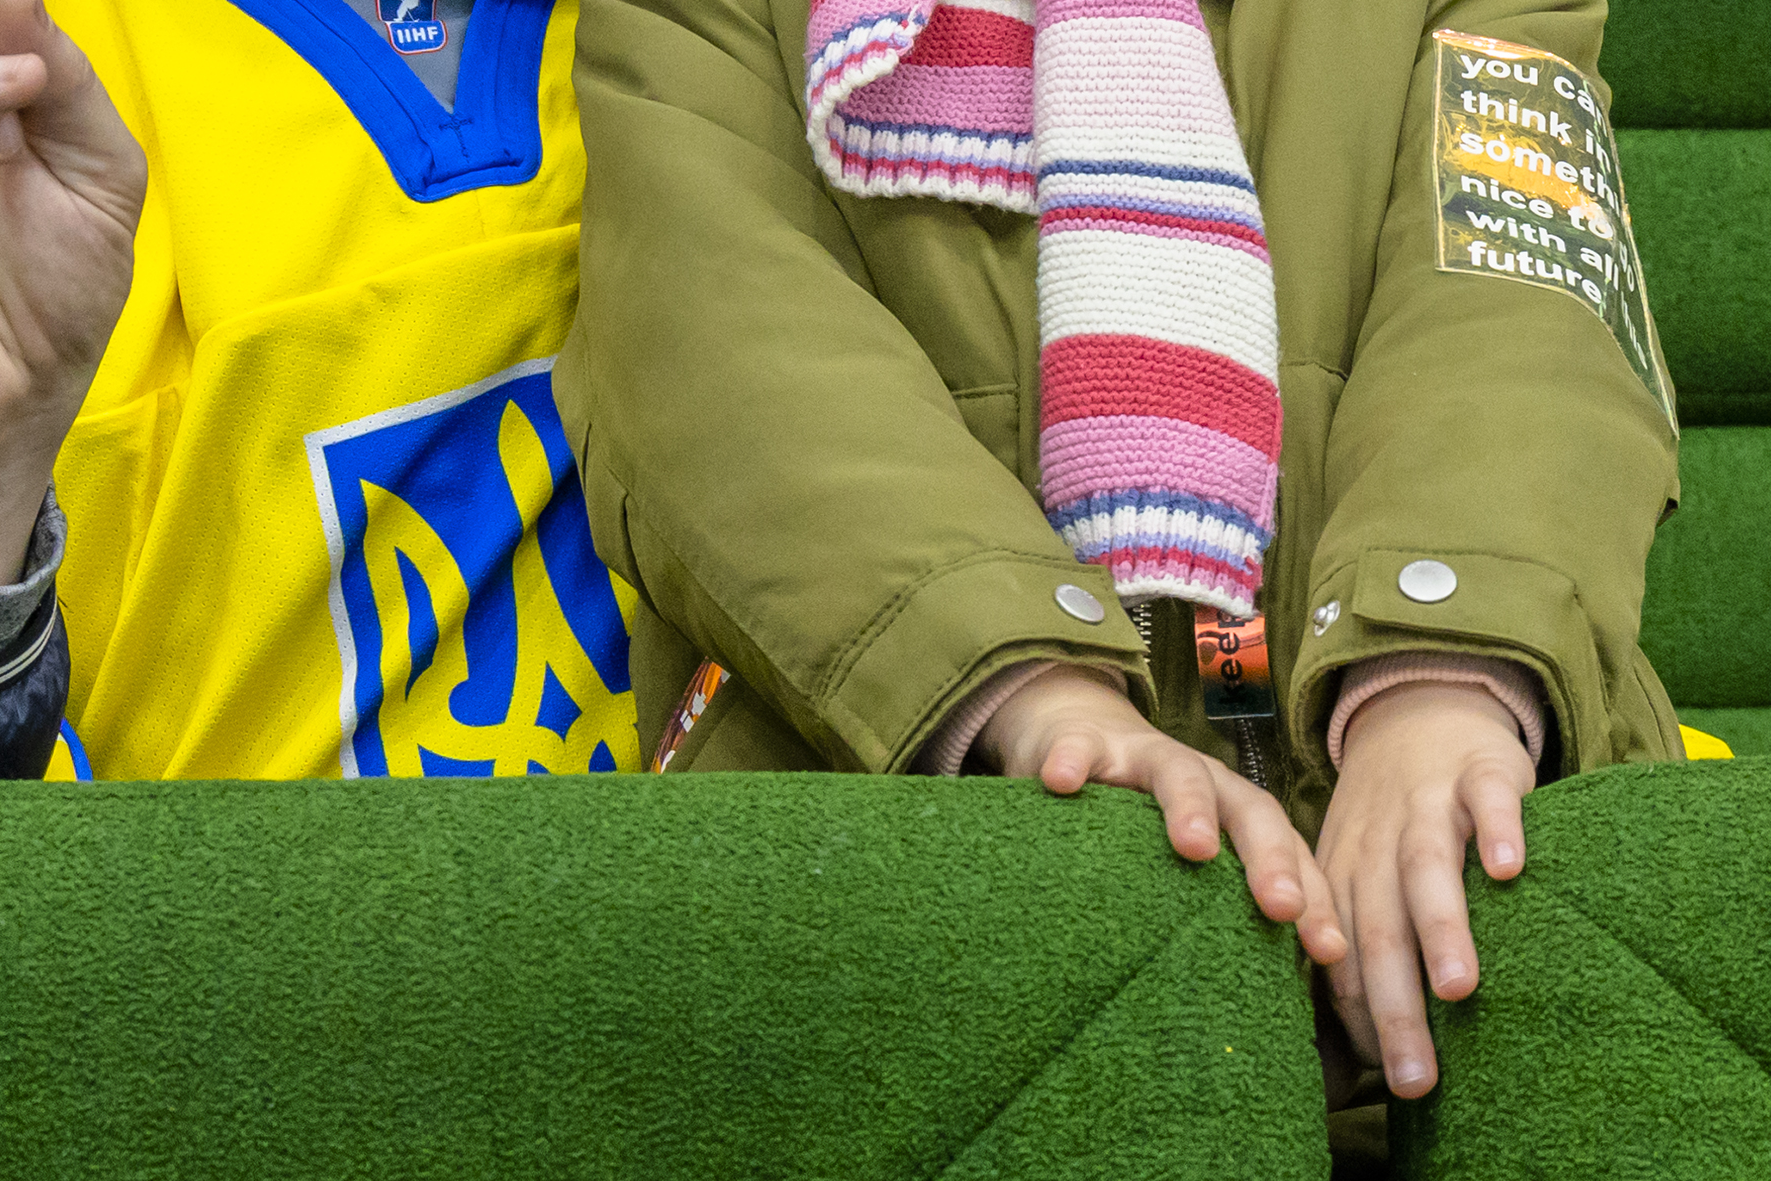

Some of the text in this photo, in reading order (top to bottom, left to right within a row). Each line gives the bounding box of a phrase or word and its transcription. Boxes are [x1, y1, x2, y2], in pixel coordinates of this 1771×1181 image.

[396, 26, 439, 44] IIHF
[1460, 54, 1608, 138] you can
[1460, 89, 1612, 174] think in
[1460, 174, 1554, 219] nice
[1567, 204, 1614, 240] to
[1465, 210, 1567, 253] with
[1579, 247, 1619, 291] all
[1466, 240, 1602, 304] future
